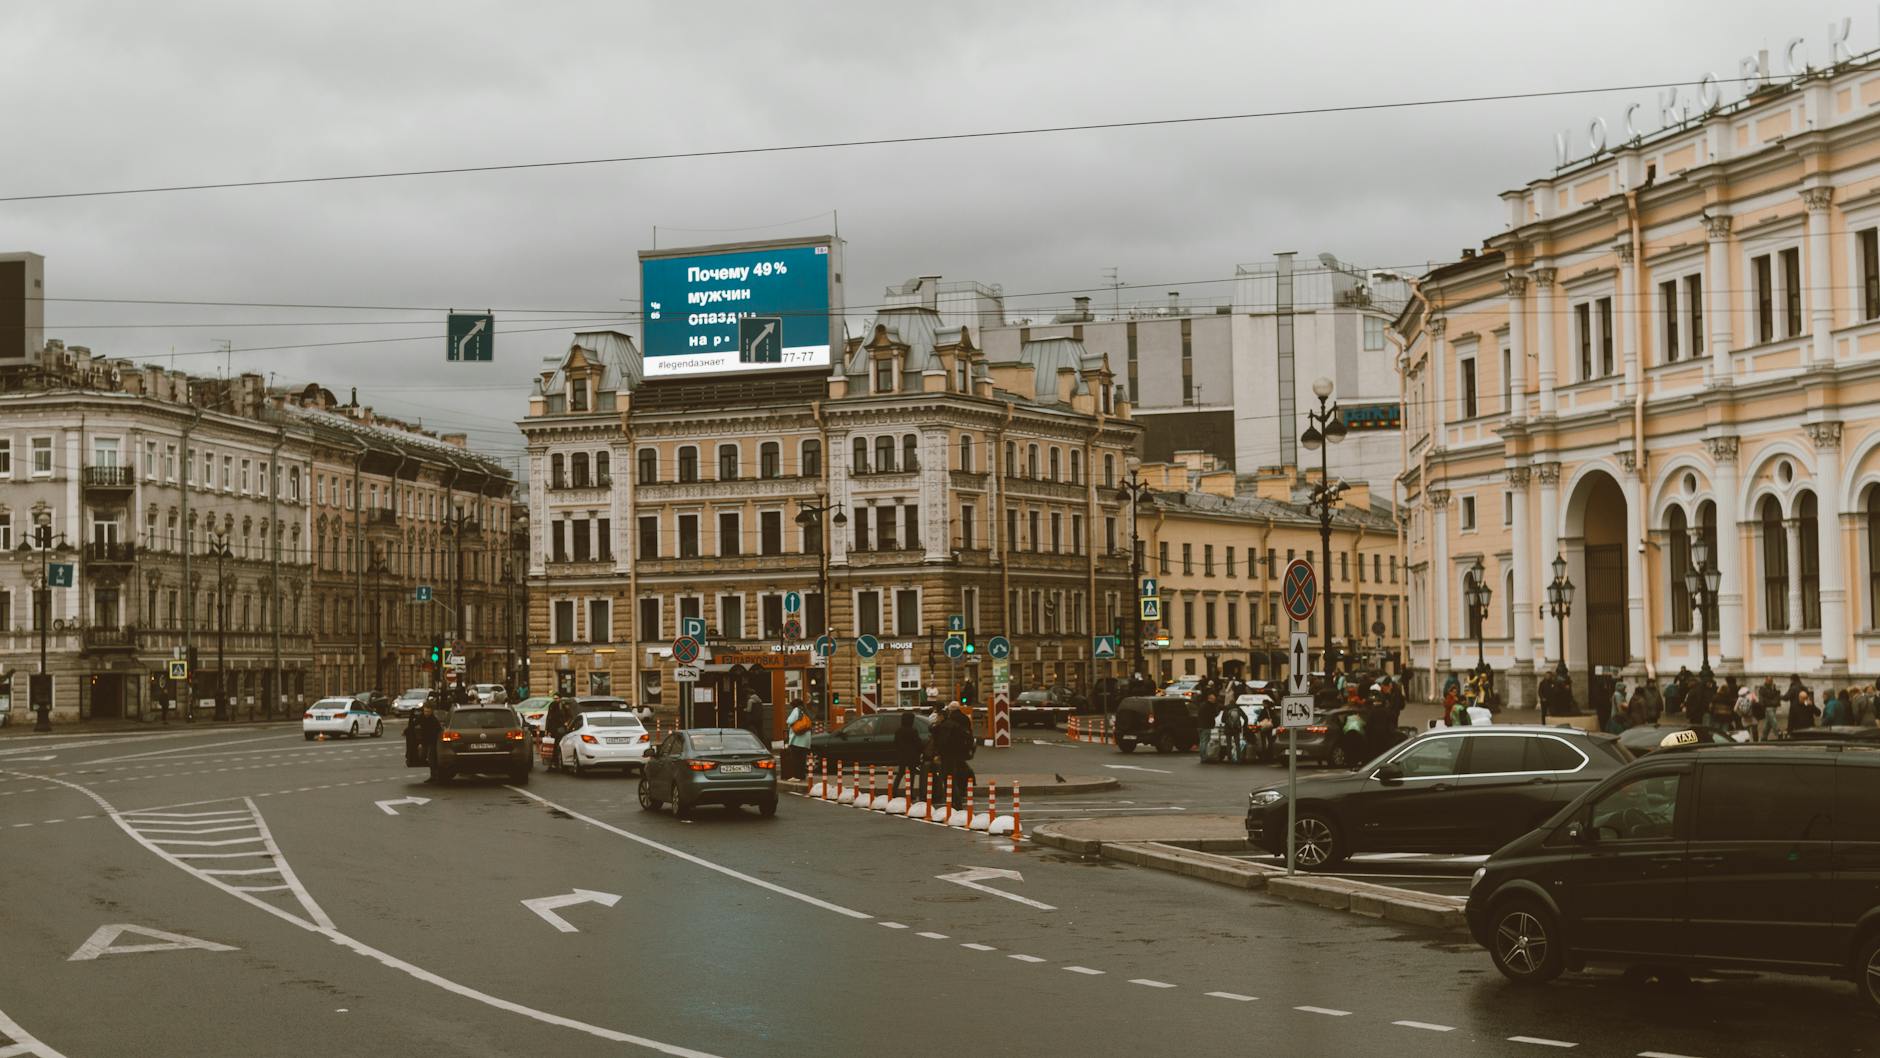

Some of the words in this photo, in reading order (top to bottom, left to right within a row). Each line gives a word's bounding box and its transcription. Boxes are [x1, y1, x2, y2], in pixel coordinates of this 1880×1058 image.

[1554, 4, 1880, 166] МОСКОВСК
[687, 266, 749, 282] Почему
[688, 288, 750, 306] мужчин
[689, 337, 707, 347] на
[689, 621, 701, 636] P
[1674, 732, 1697, 743] TAXI
